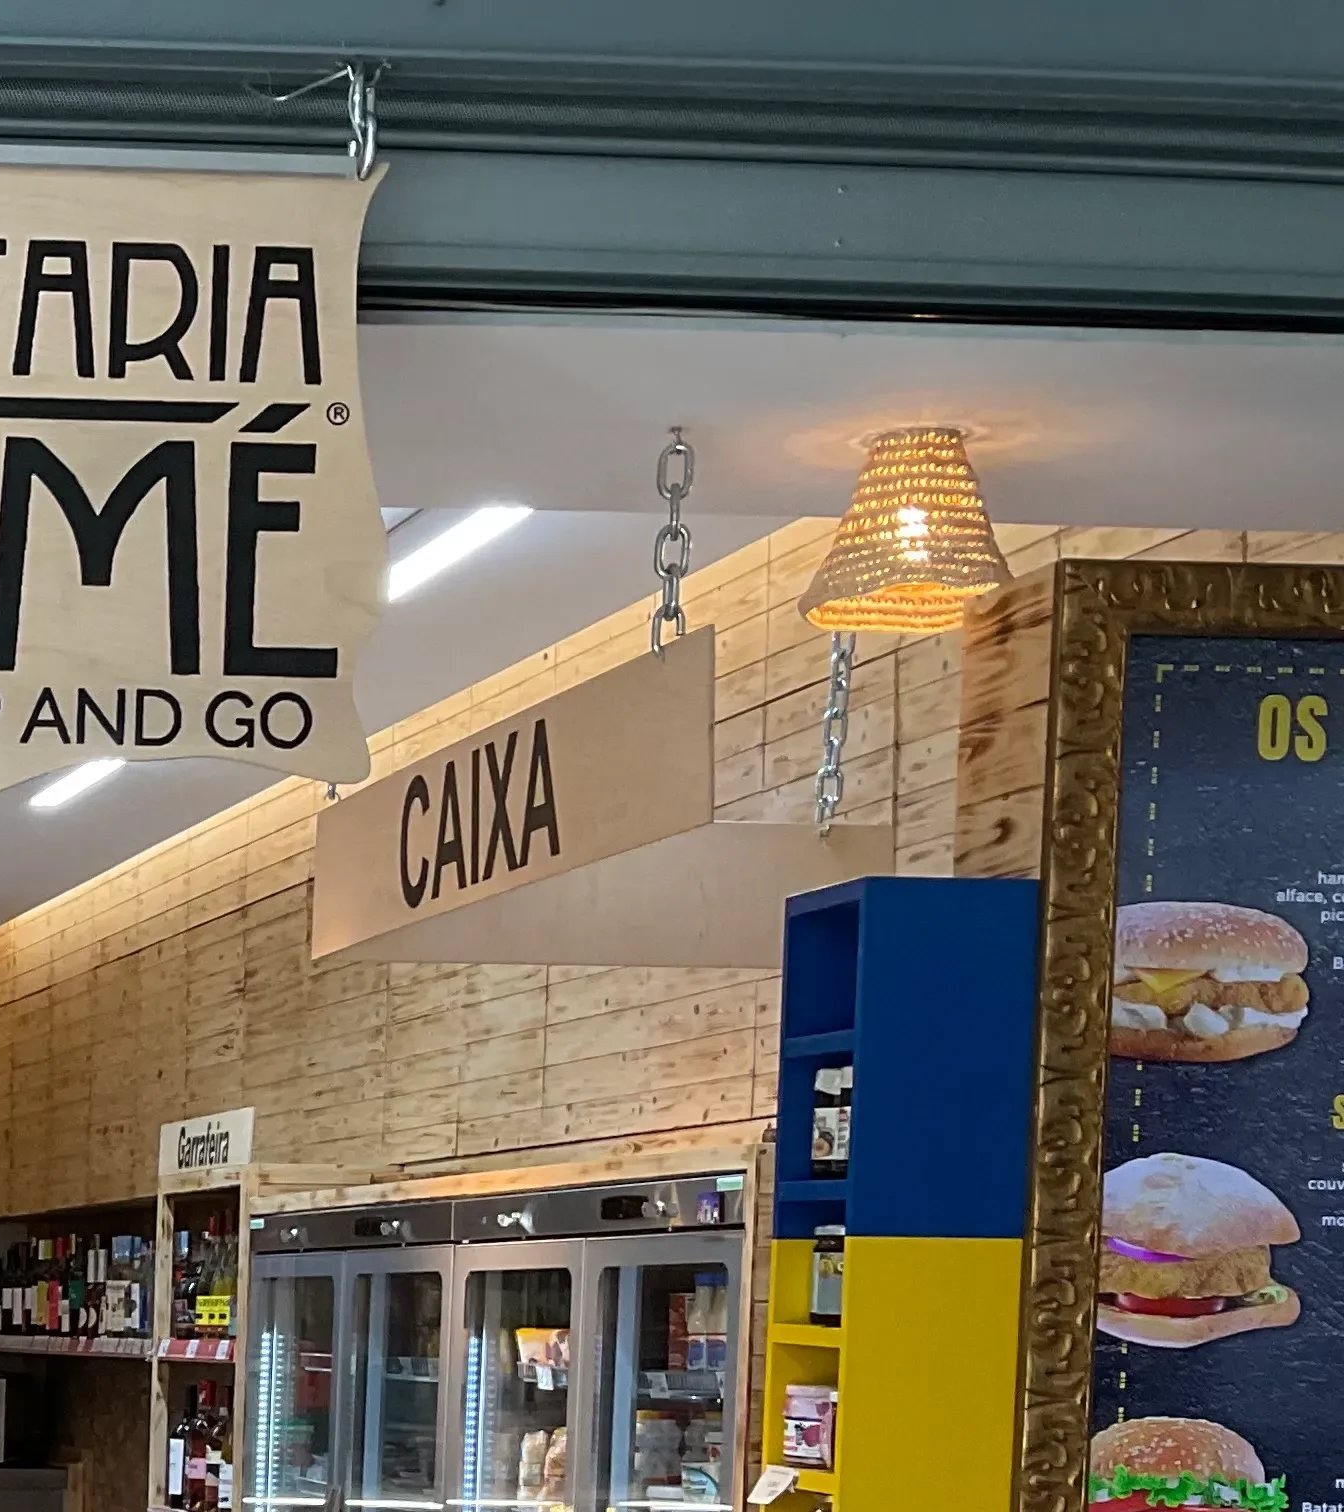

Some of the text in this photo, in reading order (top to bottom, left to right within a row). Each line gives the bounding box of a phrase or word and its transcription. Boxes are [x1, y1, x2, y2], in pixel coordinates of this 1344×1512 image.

[19, 686, 184, 747] AND
[204, 688, 314, 750] GO
[1257, 694, 1328, 762] OS
[400, 719, 560, 908] CAIXA
[1276, 888, 1328, 905] alface,
[178, 1121, 229, 1169] Garrafeira
